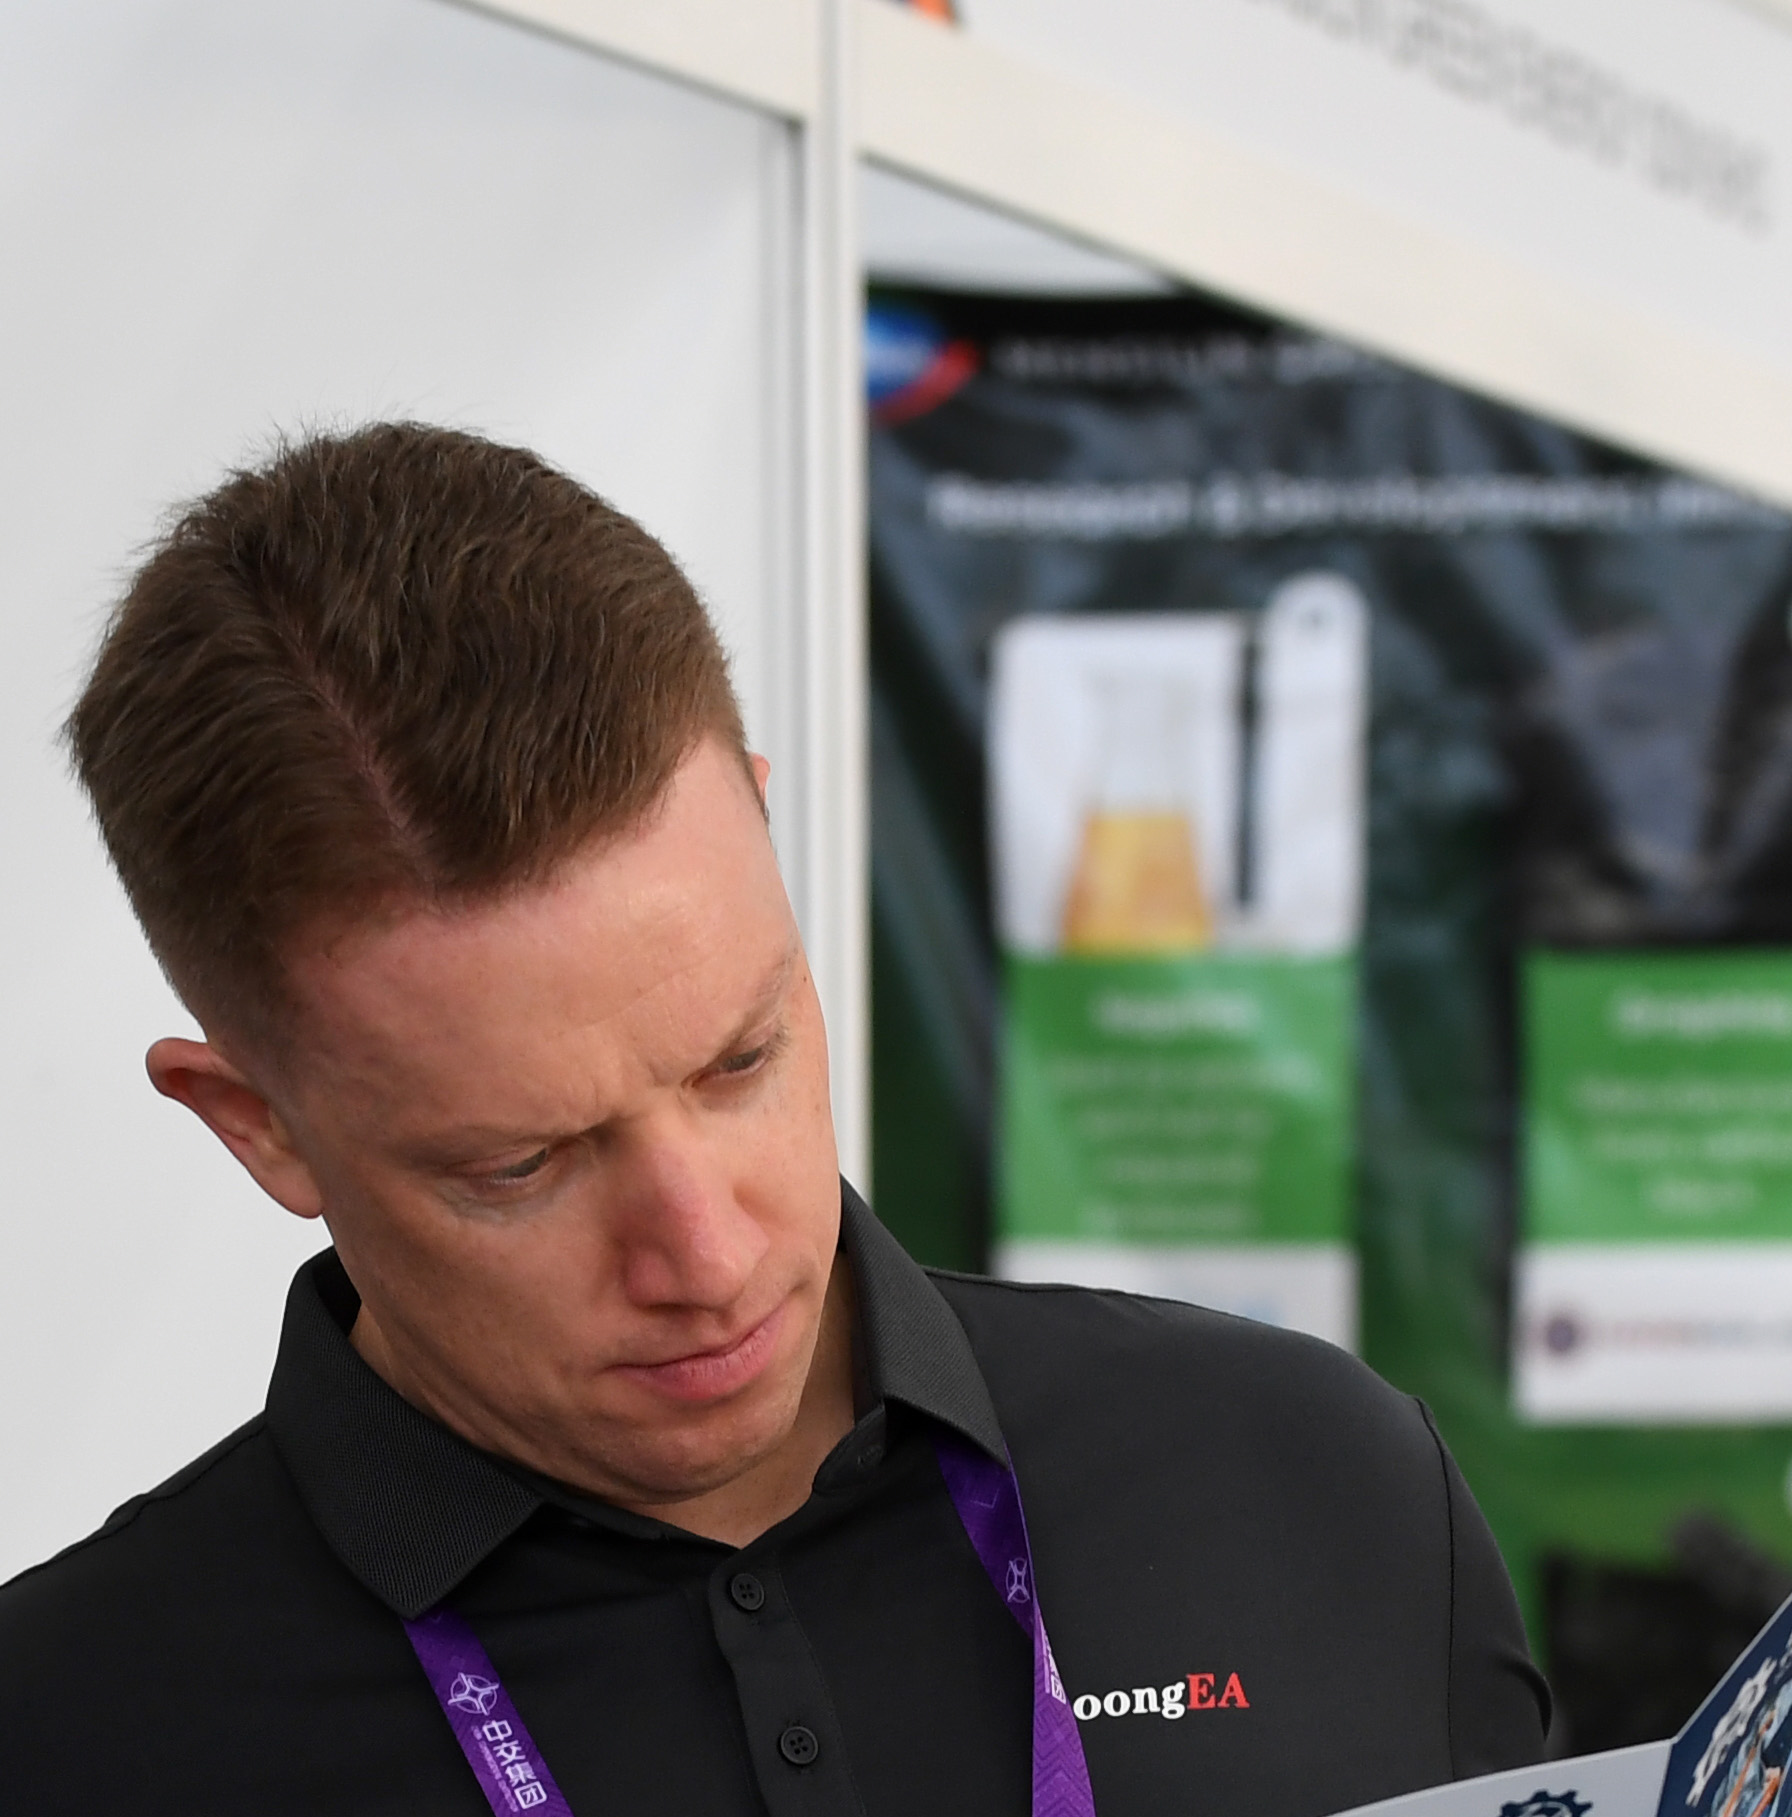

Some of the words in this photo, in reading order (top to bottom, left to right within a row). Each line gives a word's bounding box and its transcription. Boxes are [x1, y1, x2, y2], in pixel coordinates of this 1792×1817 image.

[1072, 1671, 1250, 1721] oongEA
[480, 1719, 548, 1810] 中交集团
